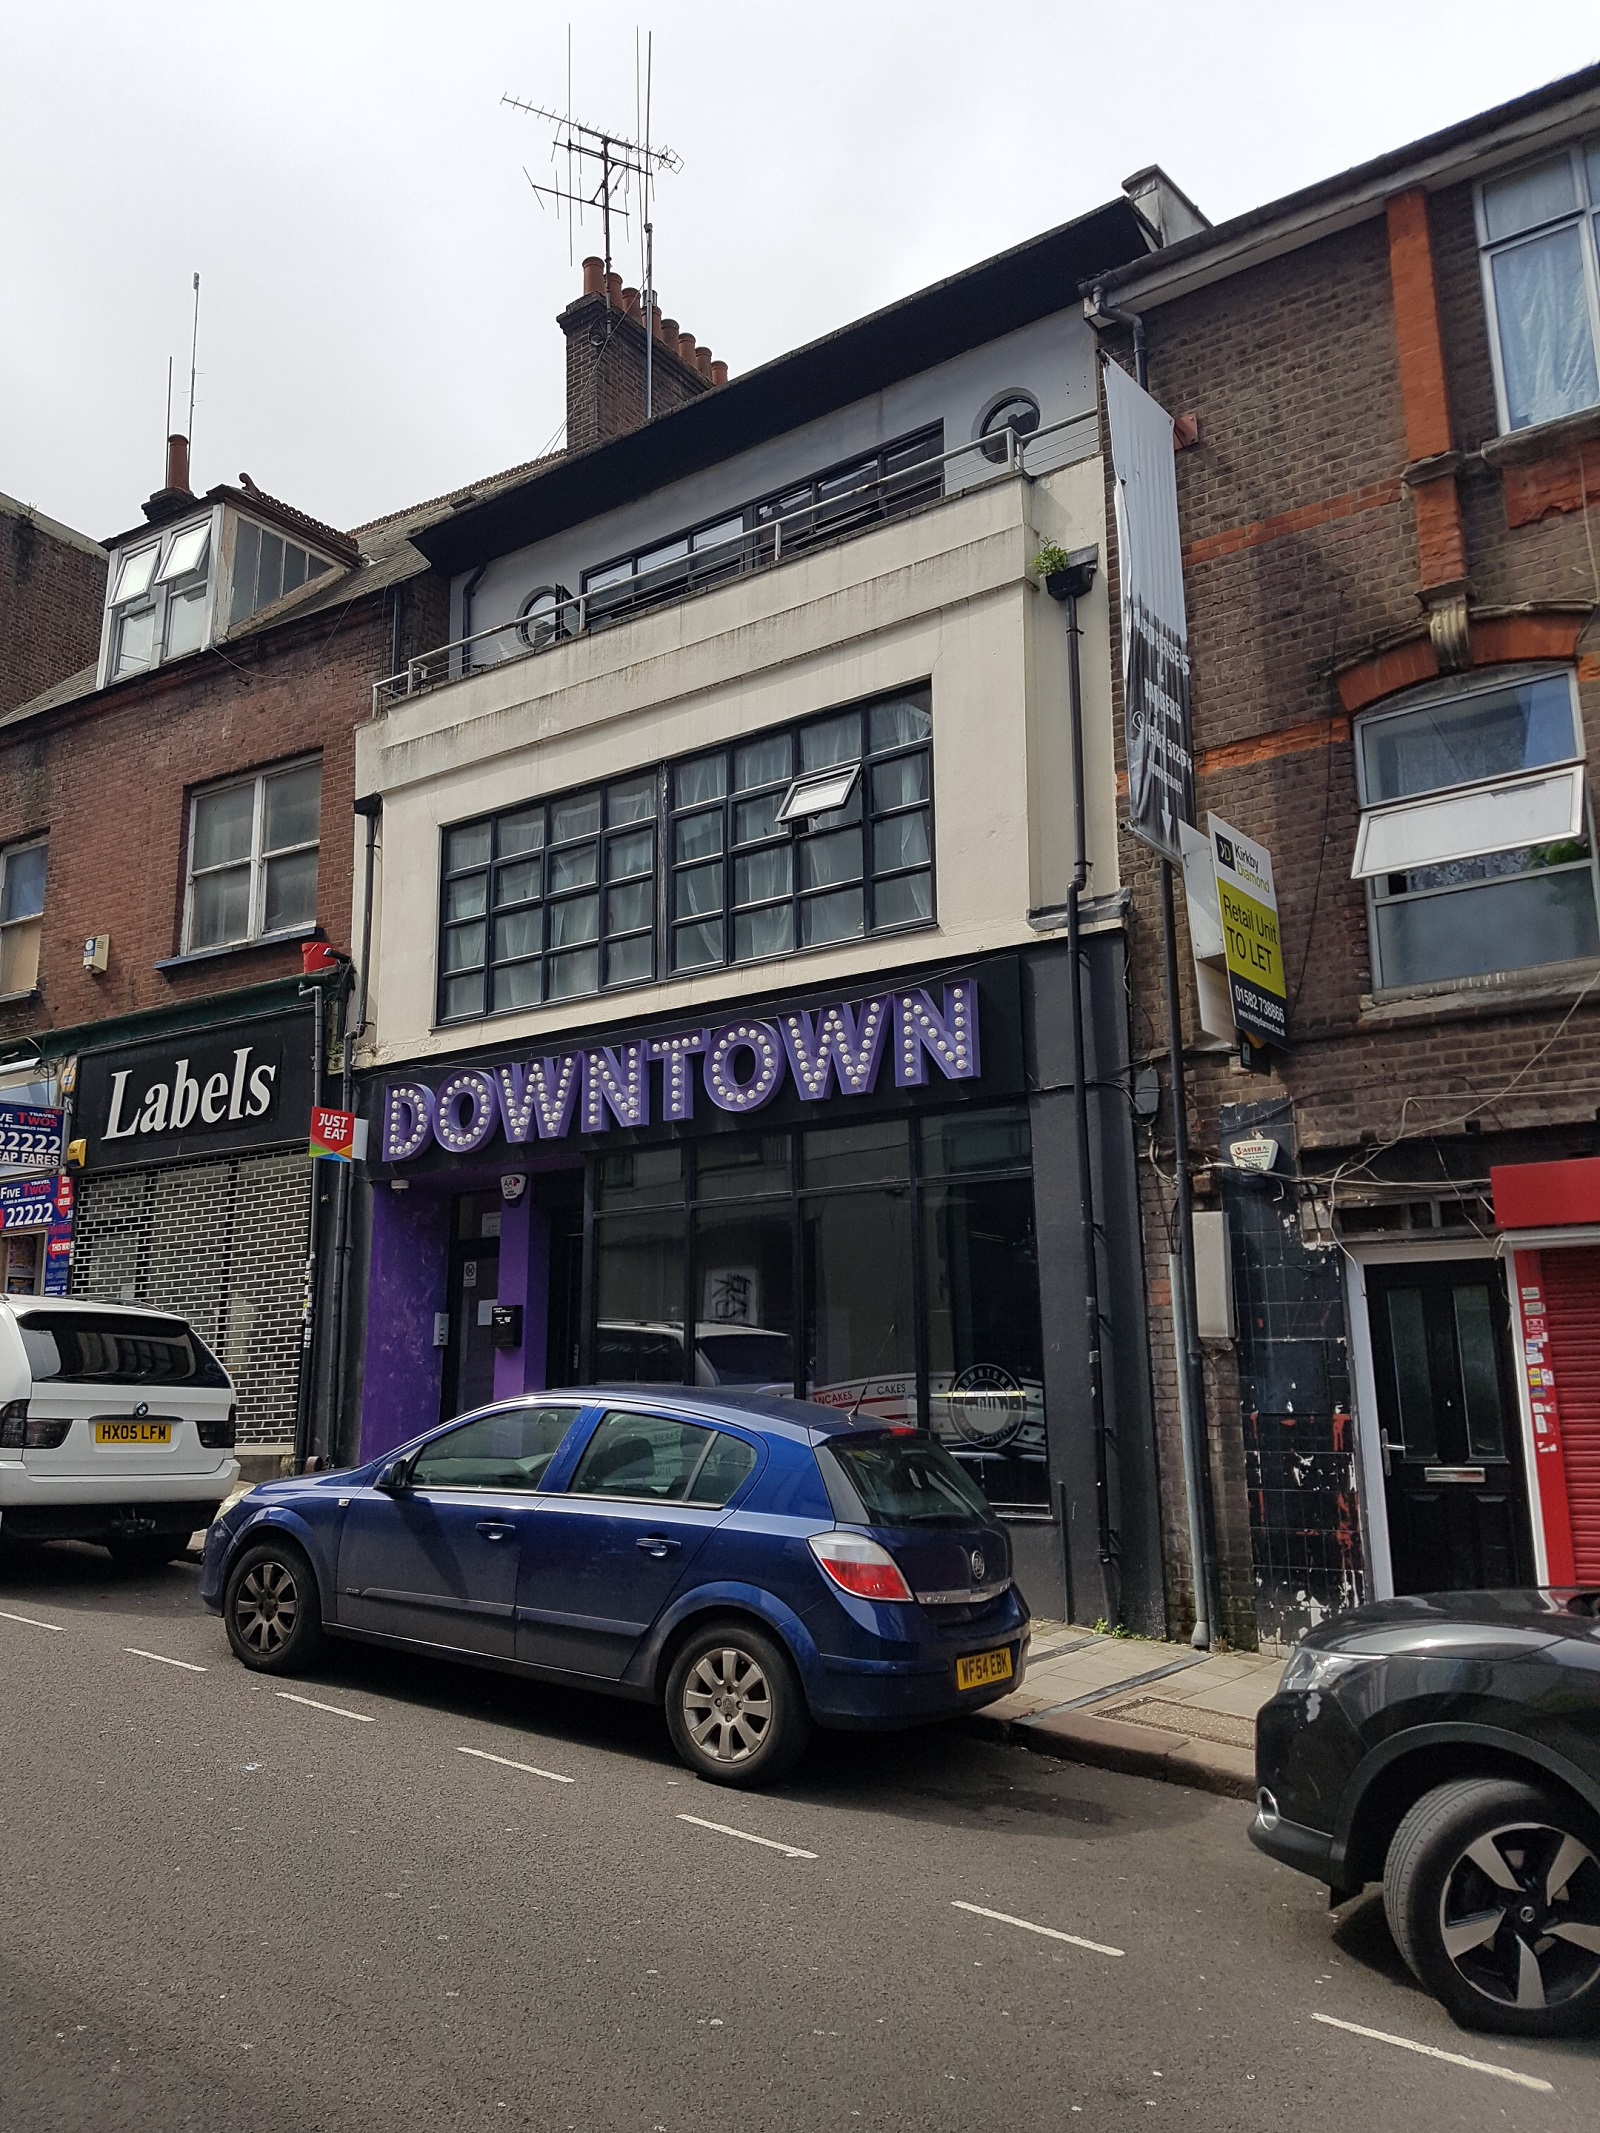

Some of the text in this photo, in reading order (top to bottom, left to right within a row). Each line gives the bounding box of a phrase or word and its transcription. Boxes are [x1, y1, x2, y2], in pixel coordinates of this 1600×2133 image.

[1234, 842, 1259, 873] Kirkby
[1236, 860, 1270, 893] Diamond
[1223, 893, 1278, 946] Retail Unit
[1226, 925, 1272, 974] TO LET
[1235, 984, 1259, 1011] 01582
[381, 978, 981, 1162] DOWNTOWN
[100, 1046, 277, 1141] Labels
[17, 1112, 58, 1127] TWOS
[29, 1111, 57, 1119] TRAVEL
[318, 1113, 348, 1128] JUST
[323, 1126, 348, 1140] EAT
[22, 1152, 59, 1166] FARES
[0, 1186, 21, 1200] FIVE
[22, 1183, 52, 1197] TWOS
[5, 1202, 54, 1228] 22222
[876, 1383, 907, 1395] CAKES
[102, 1424, 166, 1440] HX05 LFM
[990, 1651, 1009, 1676] EBK
